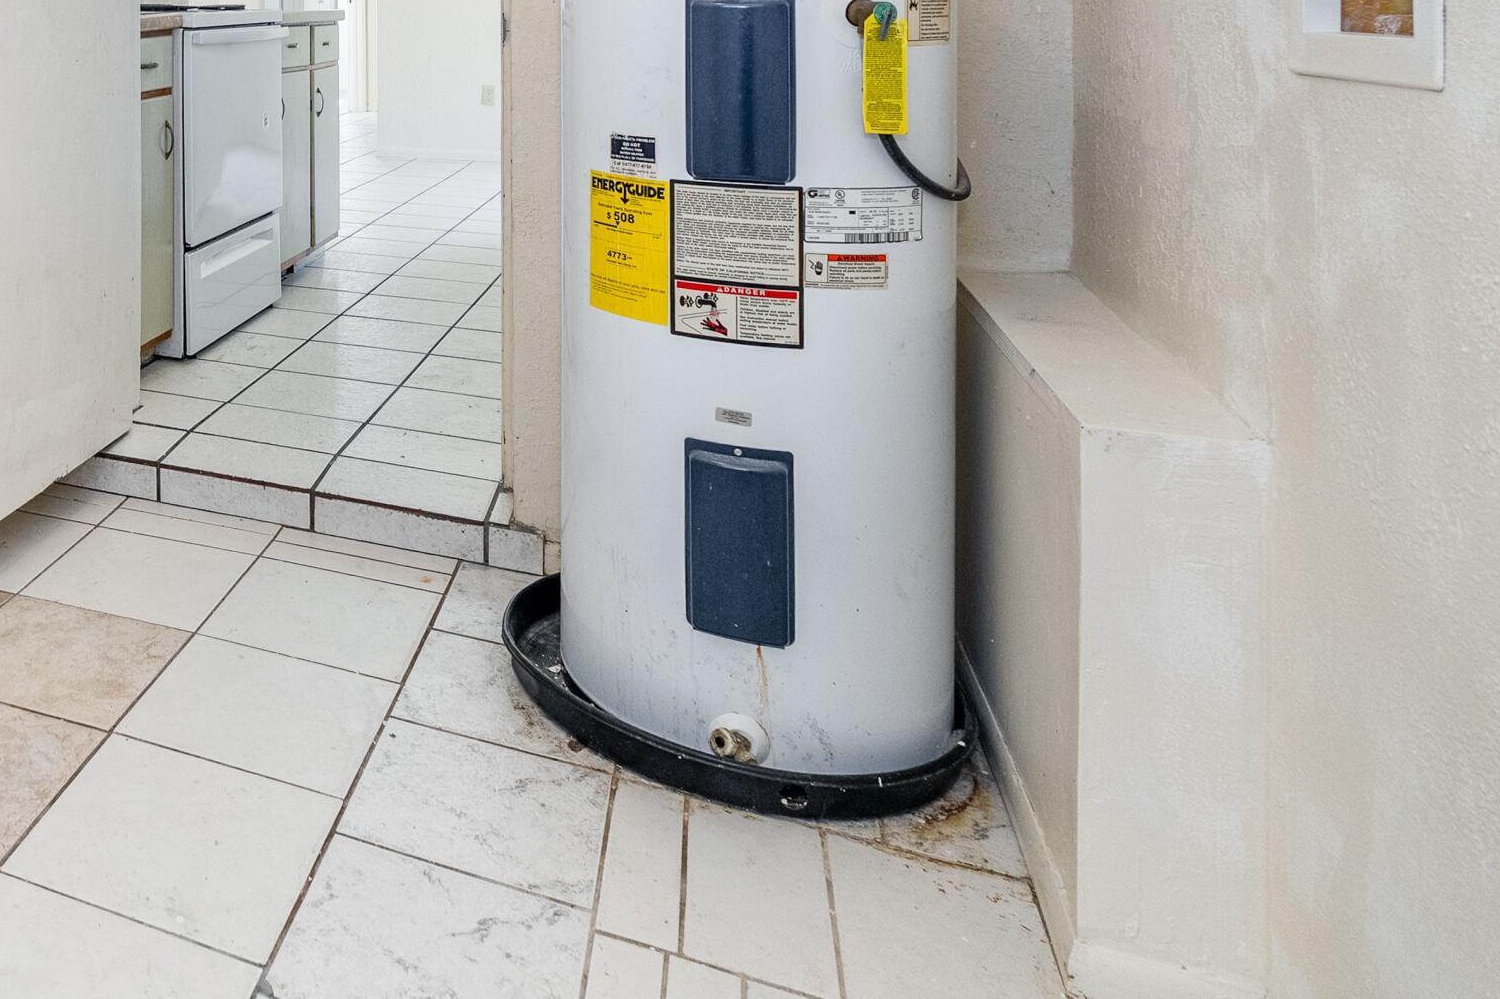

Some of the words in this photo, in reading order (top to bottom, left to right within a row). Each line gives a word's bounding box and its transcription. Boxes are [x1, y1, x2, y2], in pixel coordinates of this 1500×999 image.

[591, 176, 665, 202] ENERGYGUIDE
[614, 211, 635, 223] 508
[607, 250, 627, 261] 4773
[723, 286, 767, 297] DANGER
